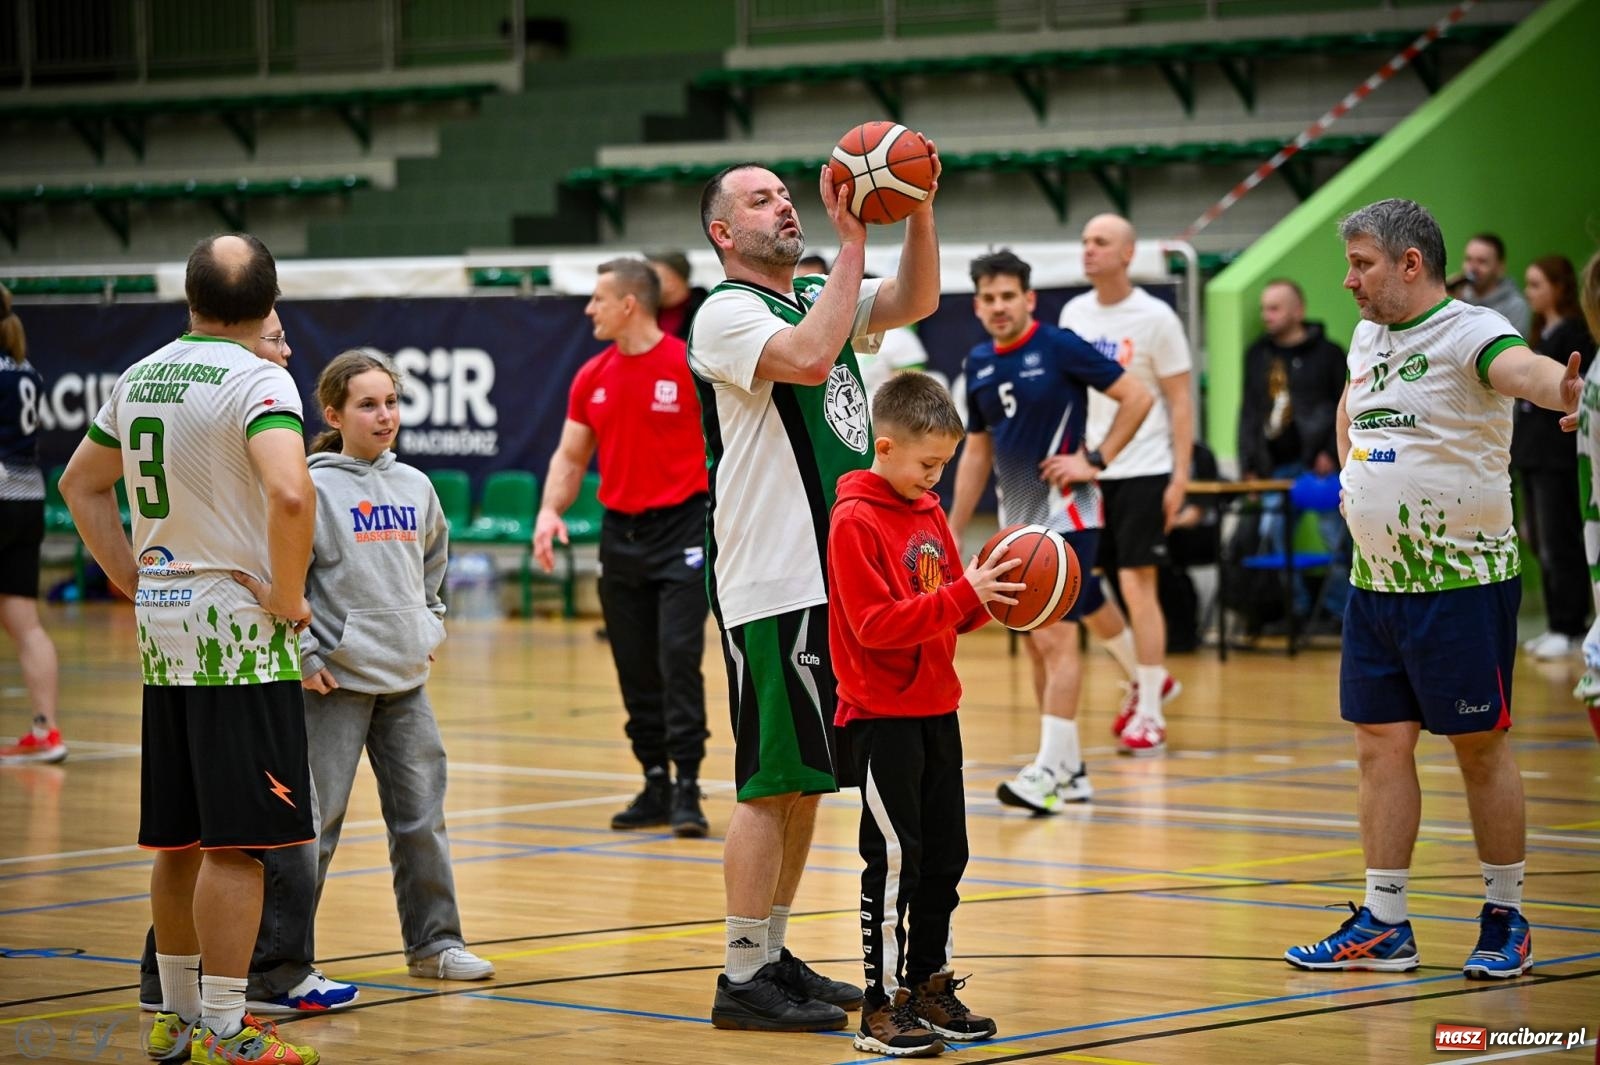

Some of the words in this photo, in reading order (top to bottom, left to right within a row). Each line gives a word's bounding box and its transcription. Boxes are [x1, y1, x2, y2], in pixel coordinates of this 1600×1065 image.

[18, 376, 37, 436] 8
[126, 381, 190, 404] RACIBÓRZ
[360, 347, 497, 427] SiR
[998, 381, 1018, 418] 5
[130, 416, 170, 519] 3
[350, 504, 417, 532] MINI
